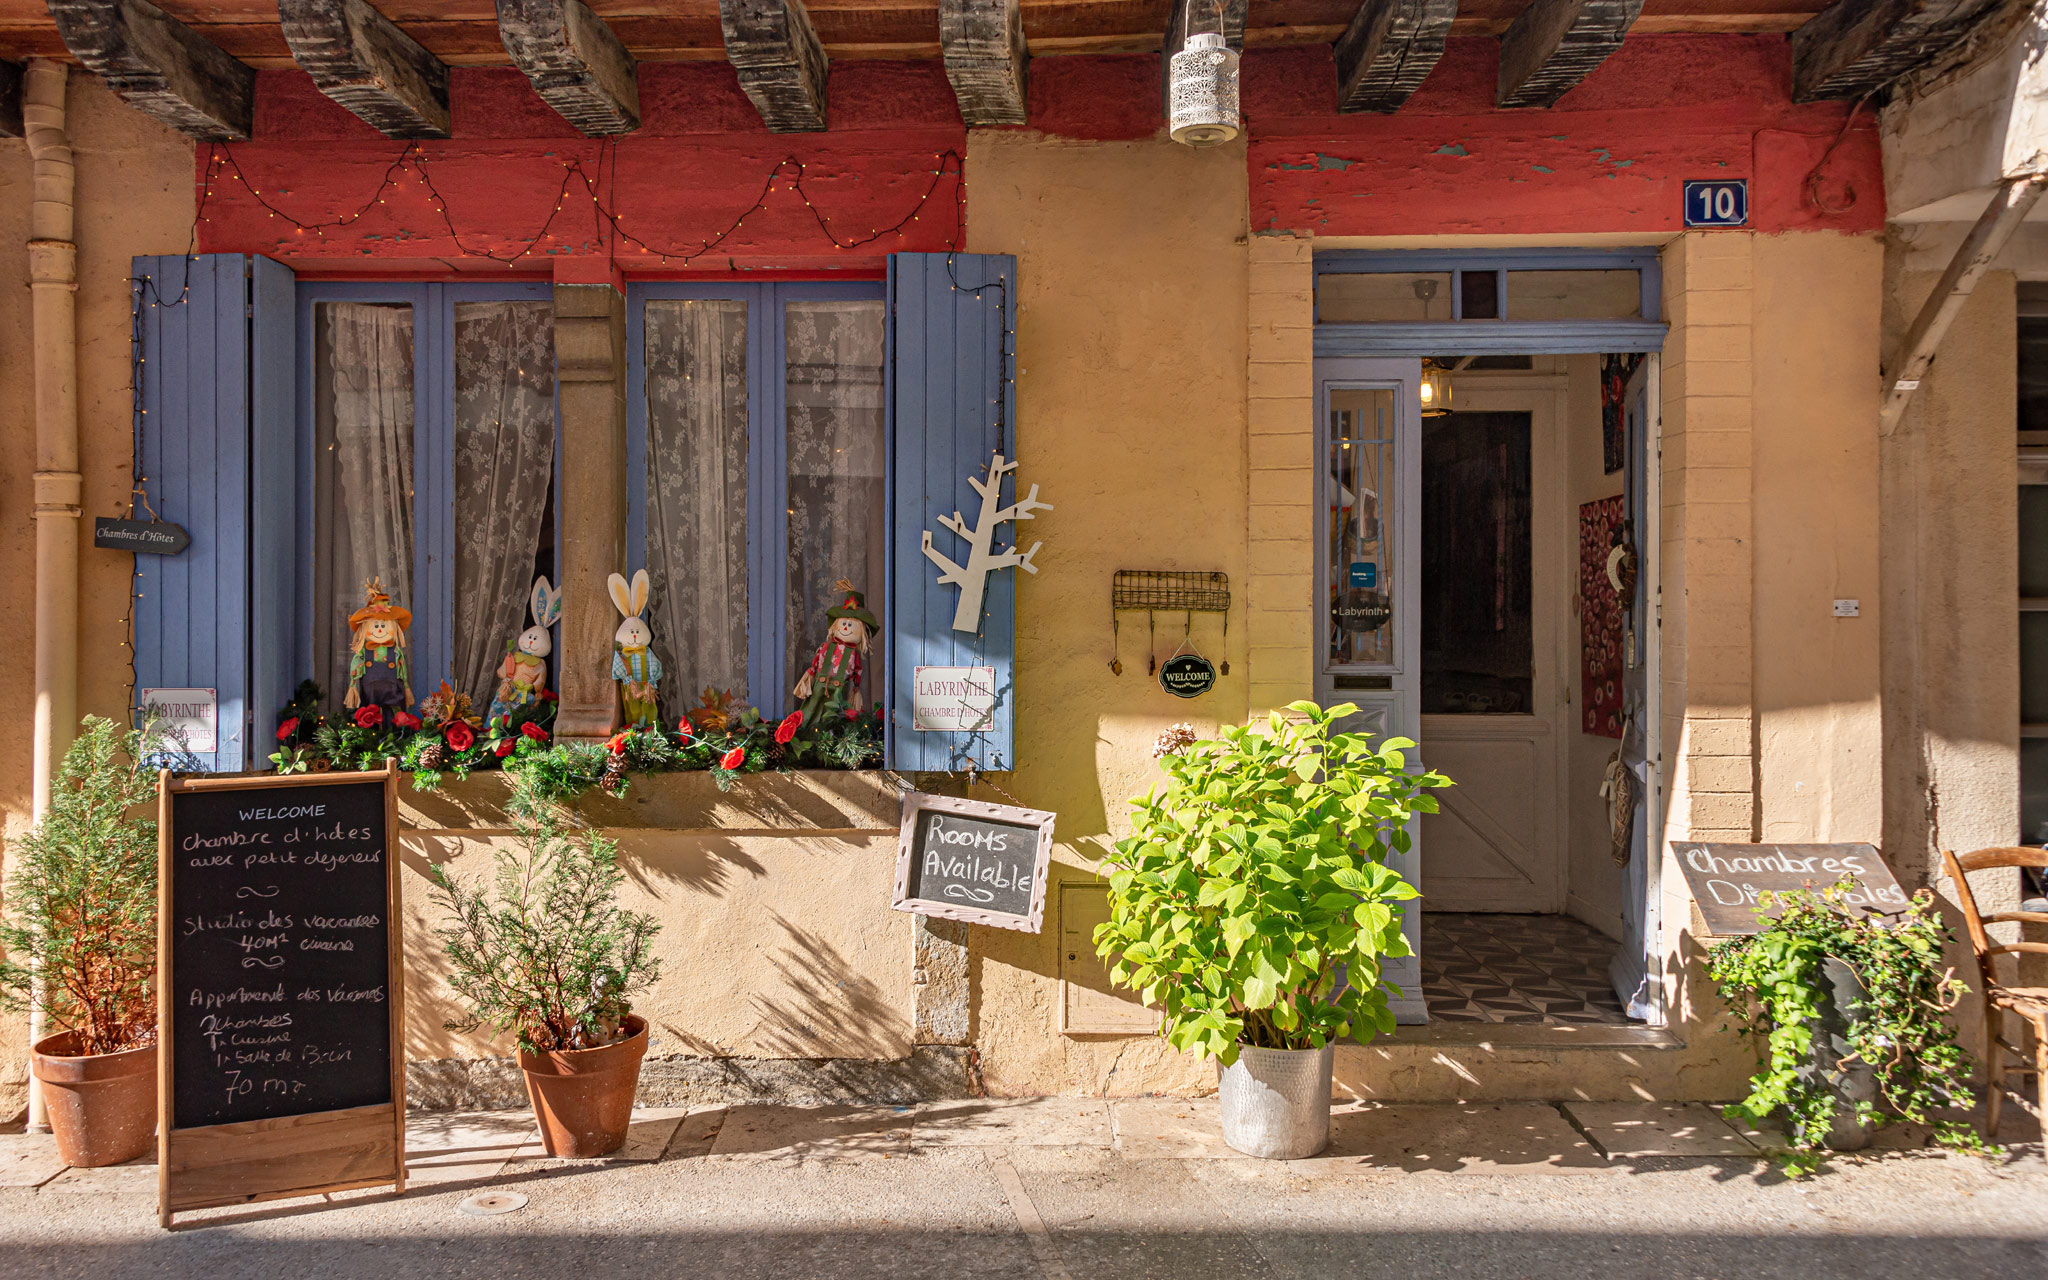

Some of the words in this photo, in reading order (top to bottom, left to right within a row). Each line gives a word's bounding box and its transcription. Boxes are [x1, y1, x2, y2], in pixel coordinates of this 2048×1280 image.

[1699, 187, 1735, 220] 10
[96, 527, 138, 540] Chambres
[139, 530, 175, 543] d'Hôtes
[1338, 607, 1383, 617] Labyrinth
[1165, 672, 1211, 682] WELCOME
[919, 681, 989, 697] LABYRINTHE
[919, 707, 956, 718] CHAMBRE
[957, 705, 989, 718] DHÔTES
[239, 804, 326, 821] WELCOME
[190, 854, 236, 867] avec
[244, 851, 299, 869] petit
[1686, 845, 1867, 875] Chambres
[925, 850, 1031, 892] Available
[258, 909, 294, 930] des
[275, 1048, 292, 1063] de
[224, 1070, 253, 1105] 70
